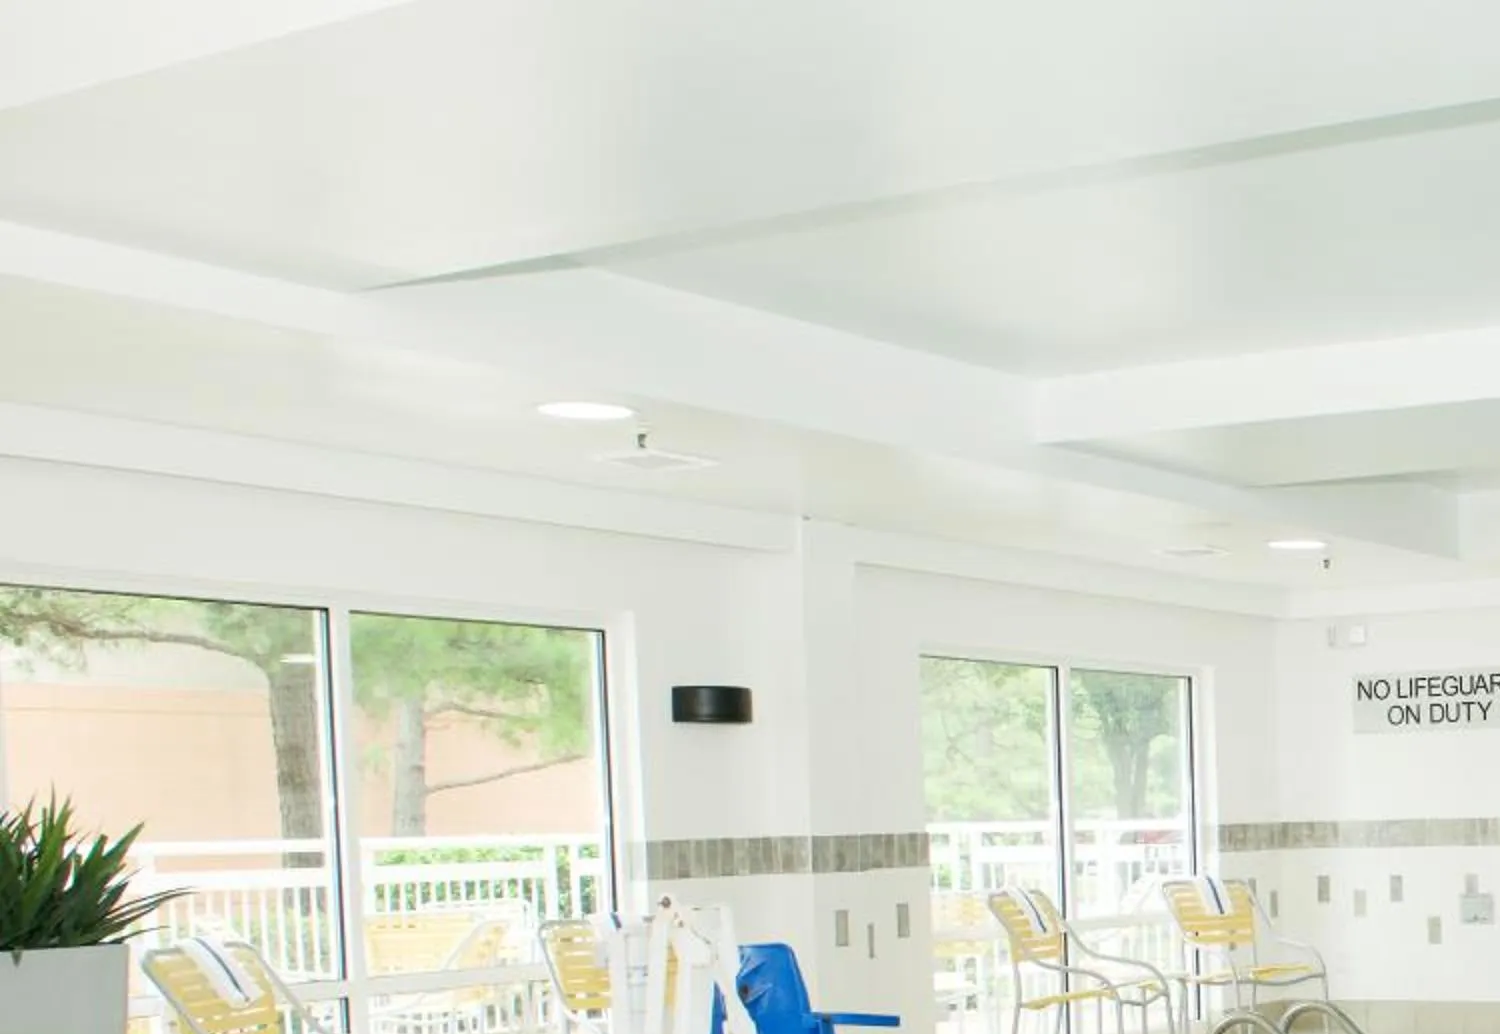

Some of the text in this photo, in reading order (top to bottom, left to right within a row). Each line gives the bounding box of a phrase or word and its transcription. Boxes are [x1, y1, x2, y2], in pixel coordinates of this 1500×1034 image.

[1357, 679, 1391, 701] NO
[1387, 701, 1493, 726] ON DUTY
